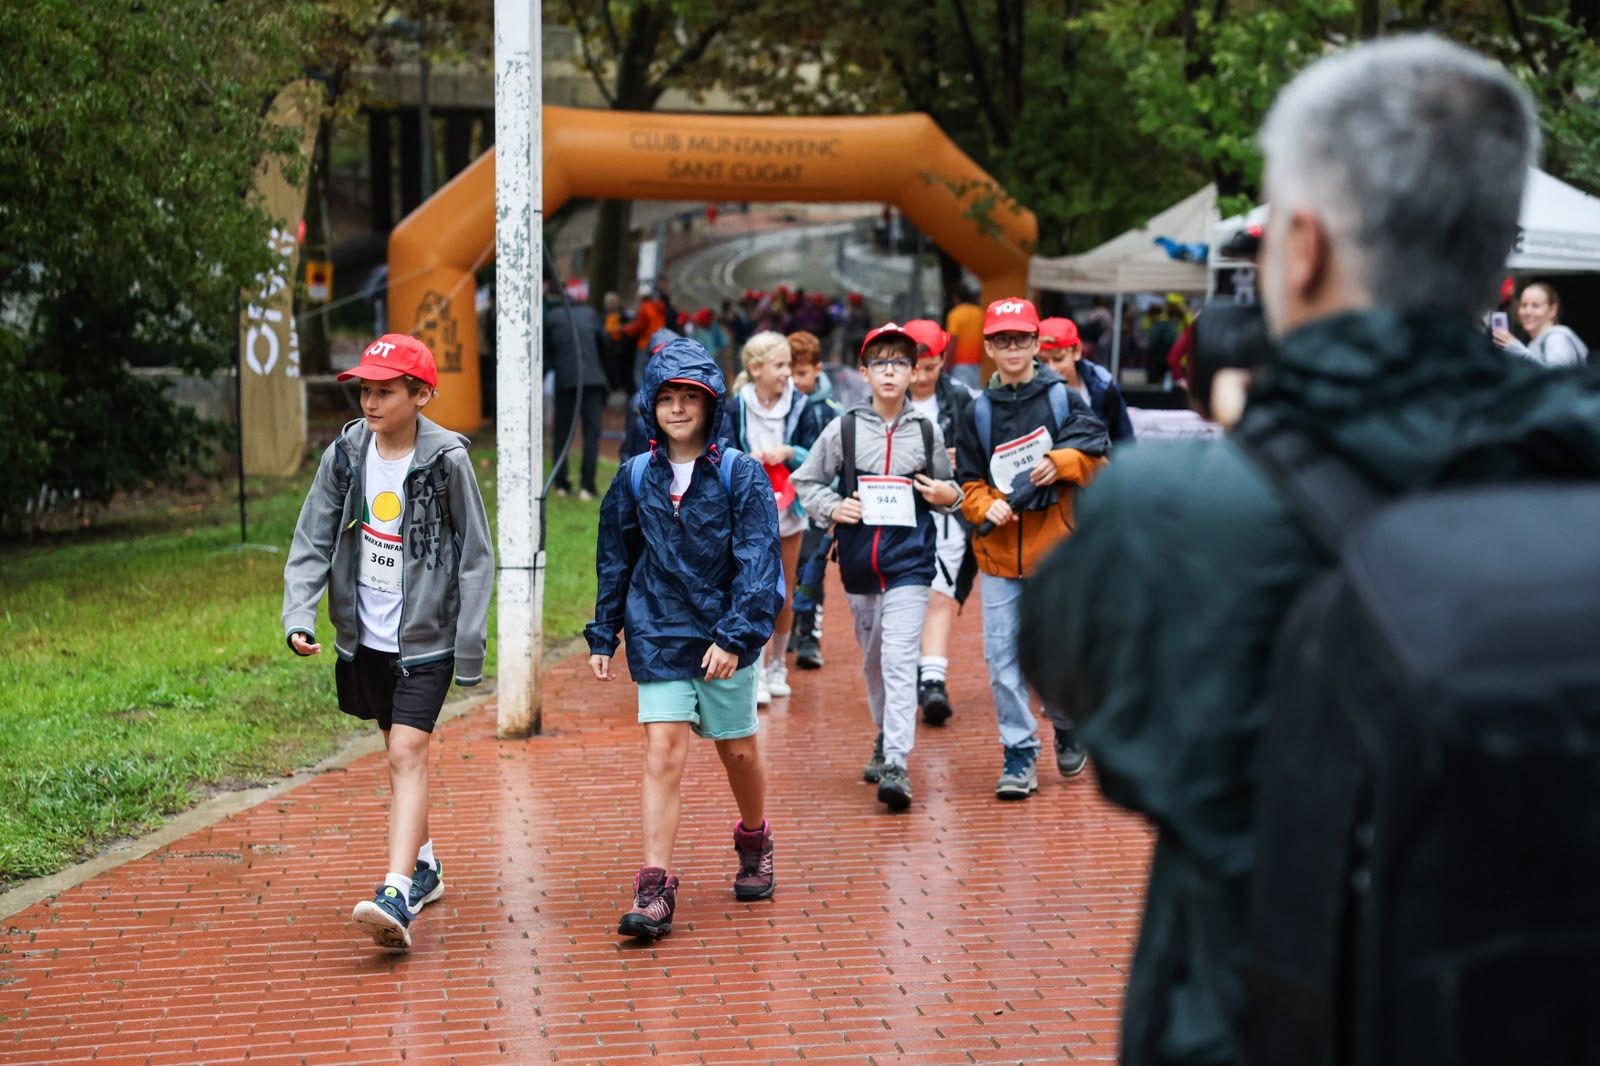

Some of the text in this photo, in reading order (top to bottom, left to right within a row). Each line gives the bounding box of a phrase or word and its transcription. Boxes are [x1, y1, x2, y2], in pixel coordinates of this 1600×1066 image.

[628, 130, 843, 158] CLUB MUNTANYENC
[667, 160, 804, 182] SANT CUGAT
[995, 301, 1024, 316] TOT
[1013, 454, 1034, 468] 94B
[876, 495, 898, 504] 94A
[364, 534, 382, 548] MARXA
[370, 552, 396, 568] 36B
